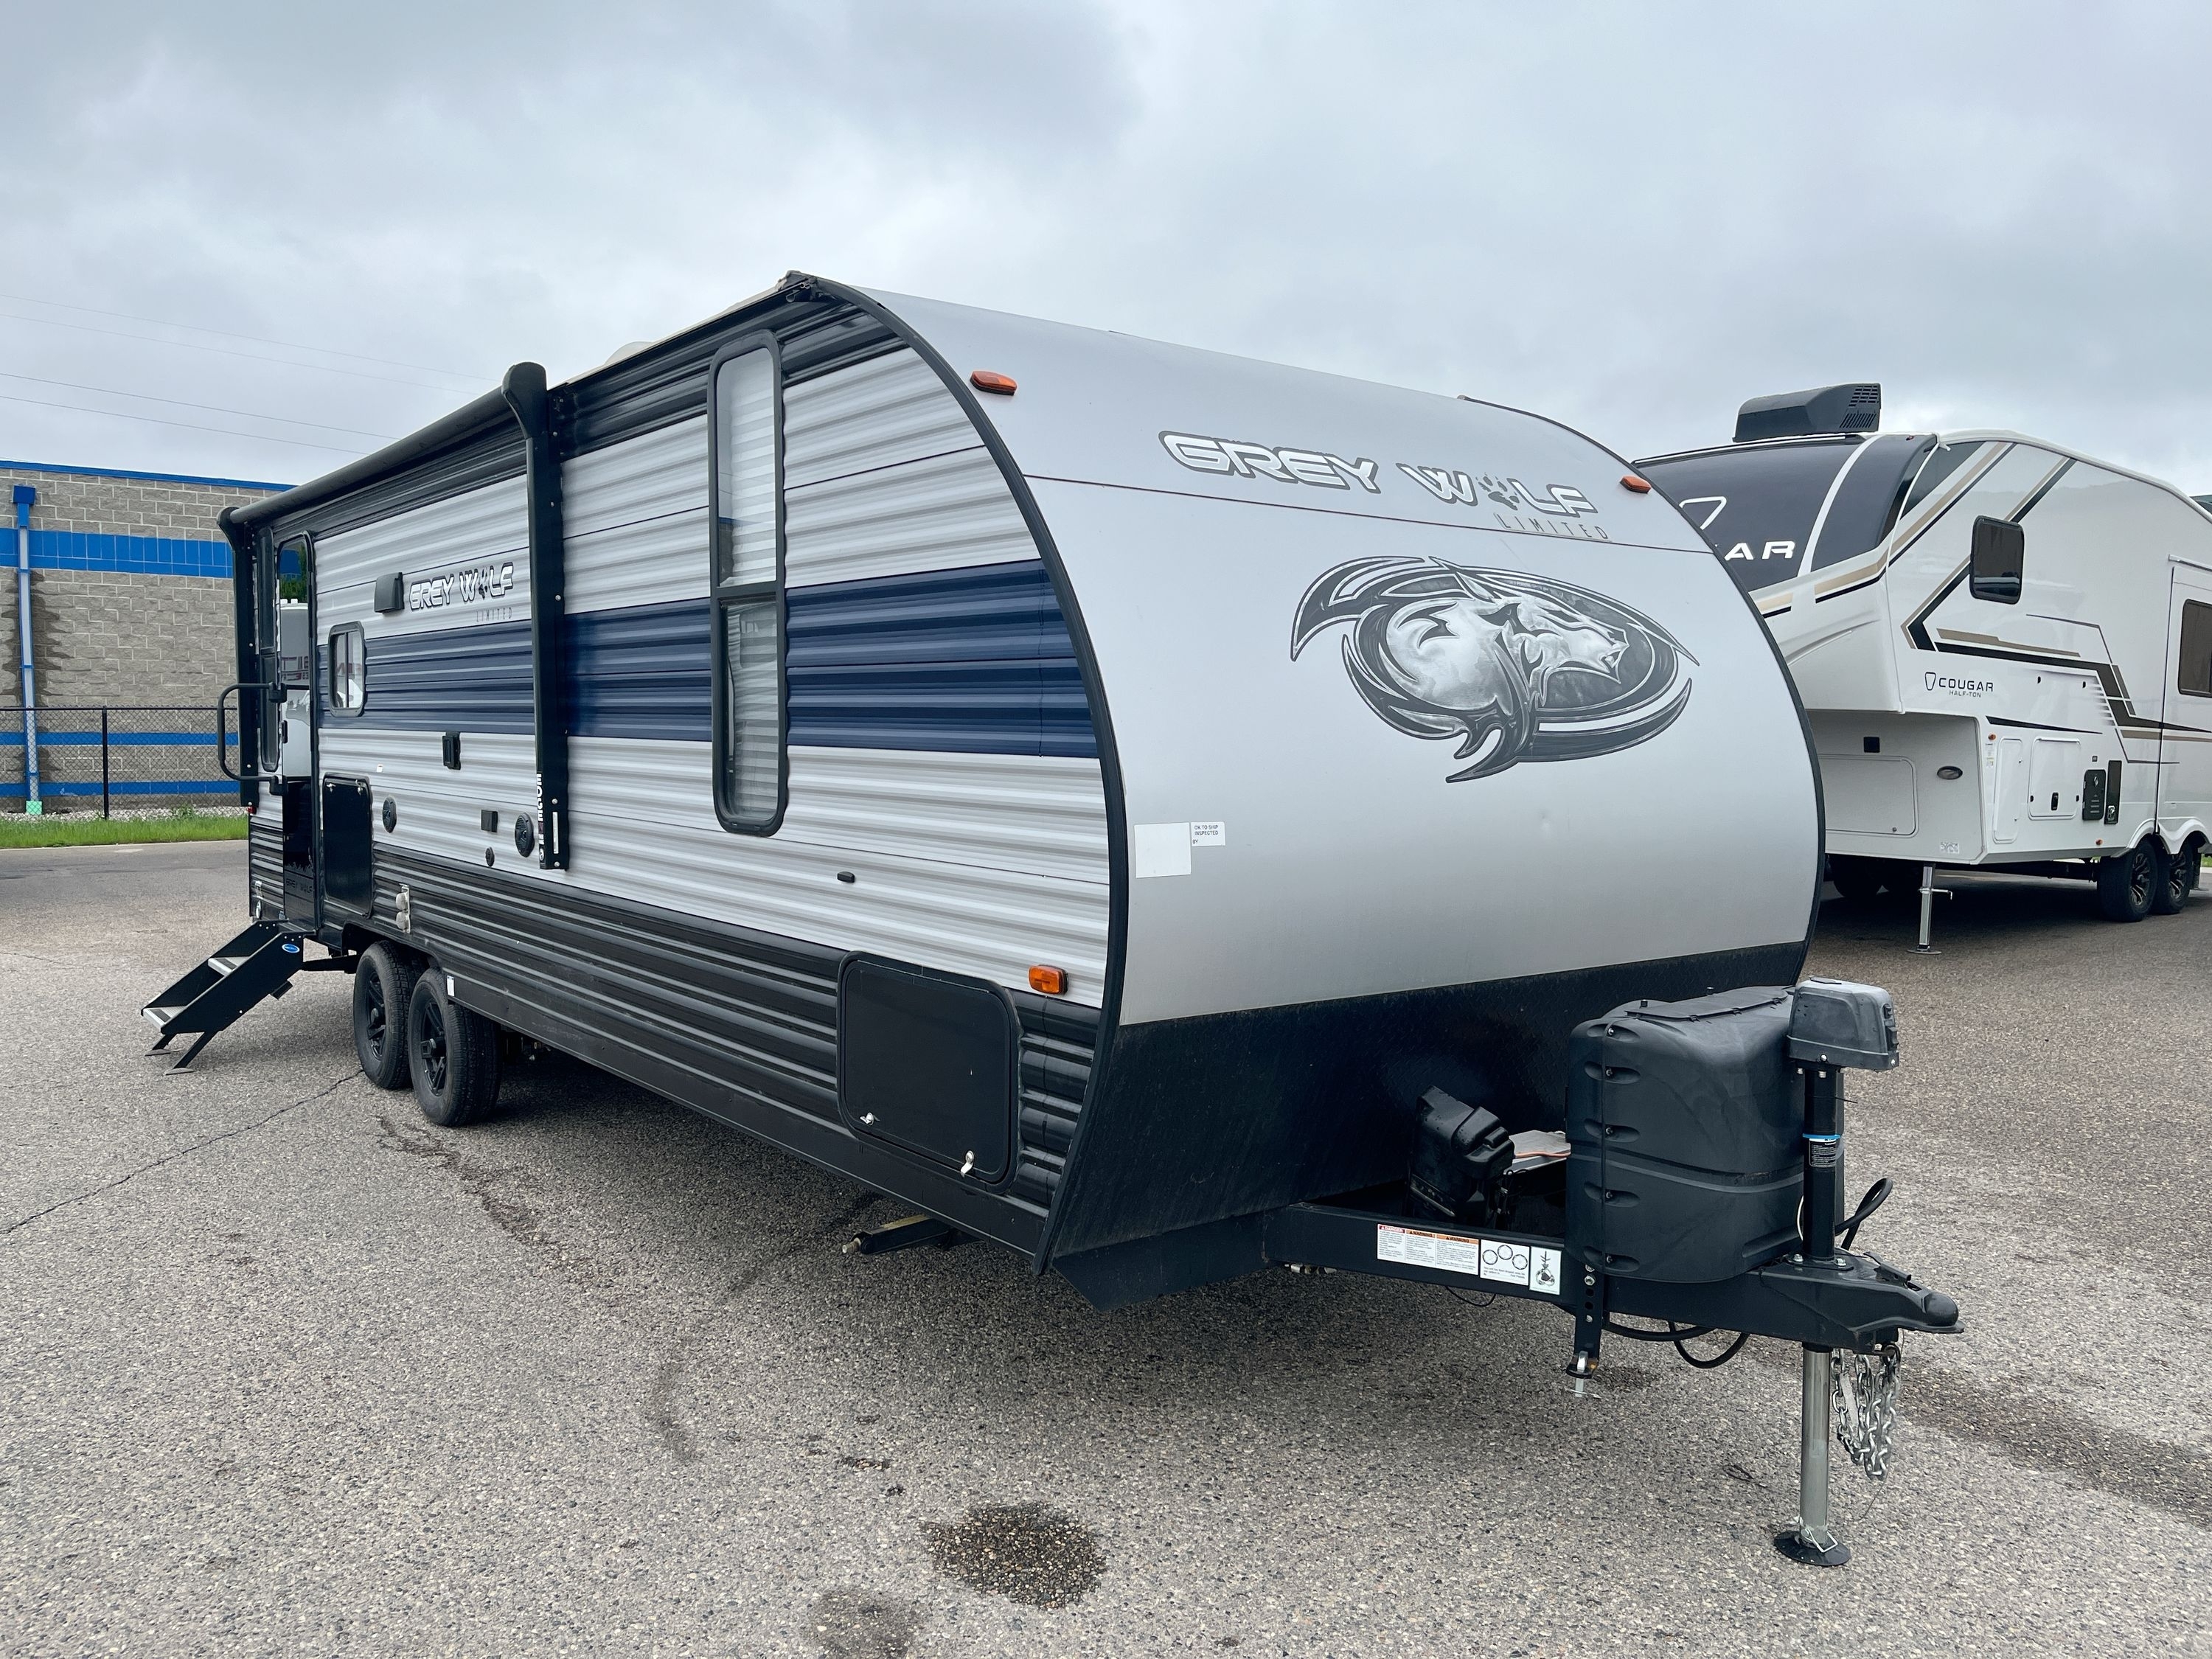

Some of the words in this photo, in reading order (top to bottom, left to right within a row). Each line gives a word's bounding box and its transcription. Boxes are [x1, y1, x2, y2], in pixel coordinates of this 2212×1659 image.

[1158, 431, 1381, 493] GREY
[1495, 512, 1608, 540] LIMITED
[1715, 540, 1795, 561] AR
[410, 573, 455, 611] GREY
[476, 607, 512, 622] LIMITED
[1938, 678, 1994, 692] COUGAR
[1949, 690, 1981, 698] HALF-TON
